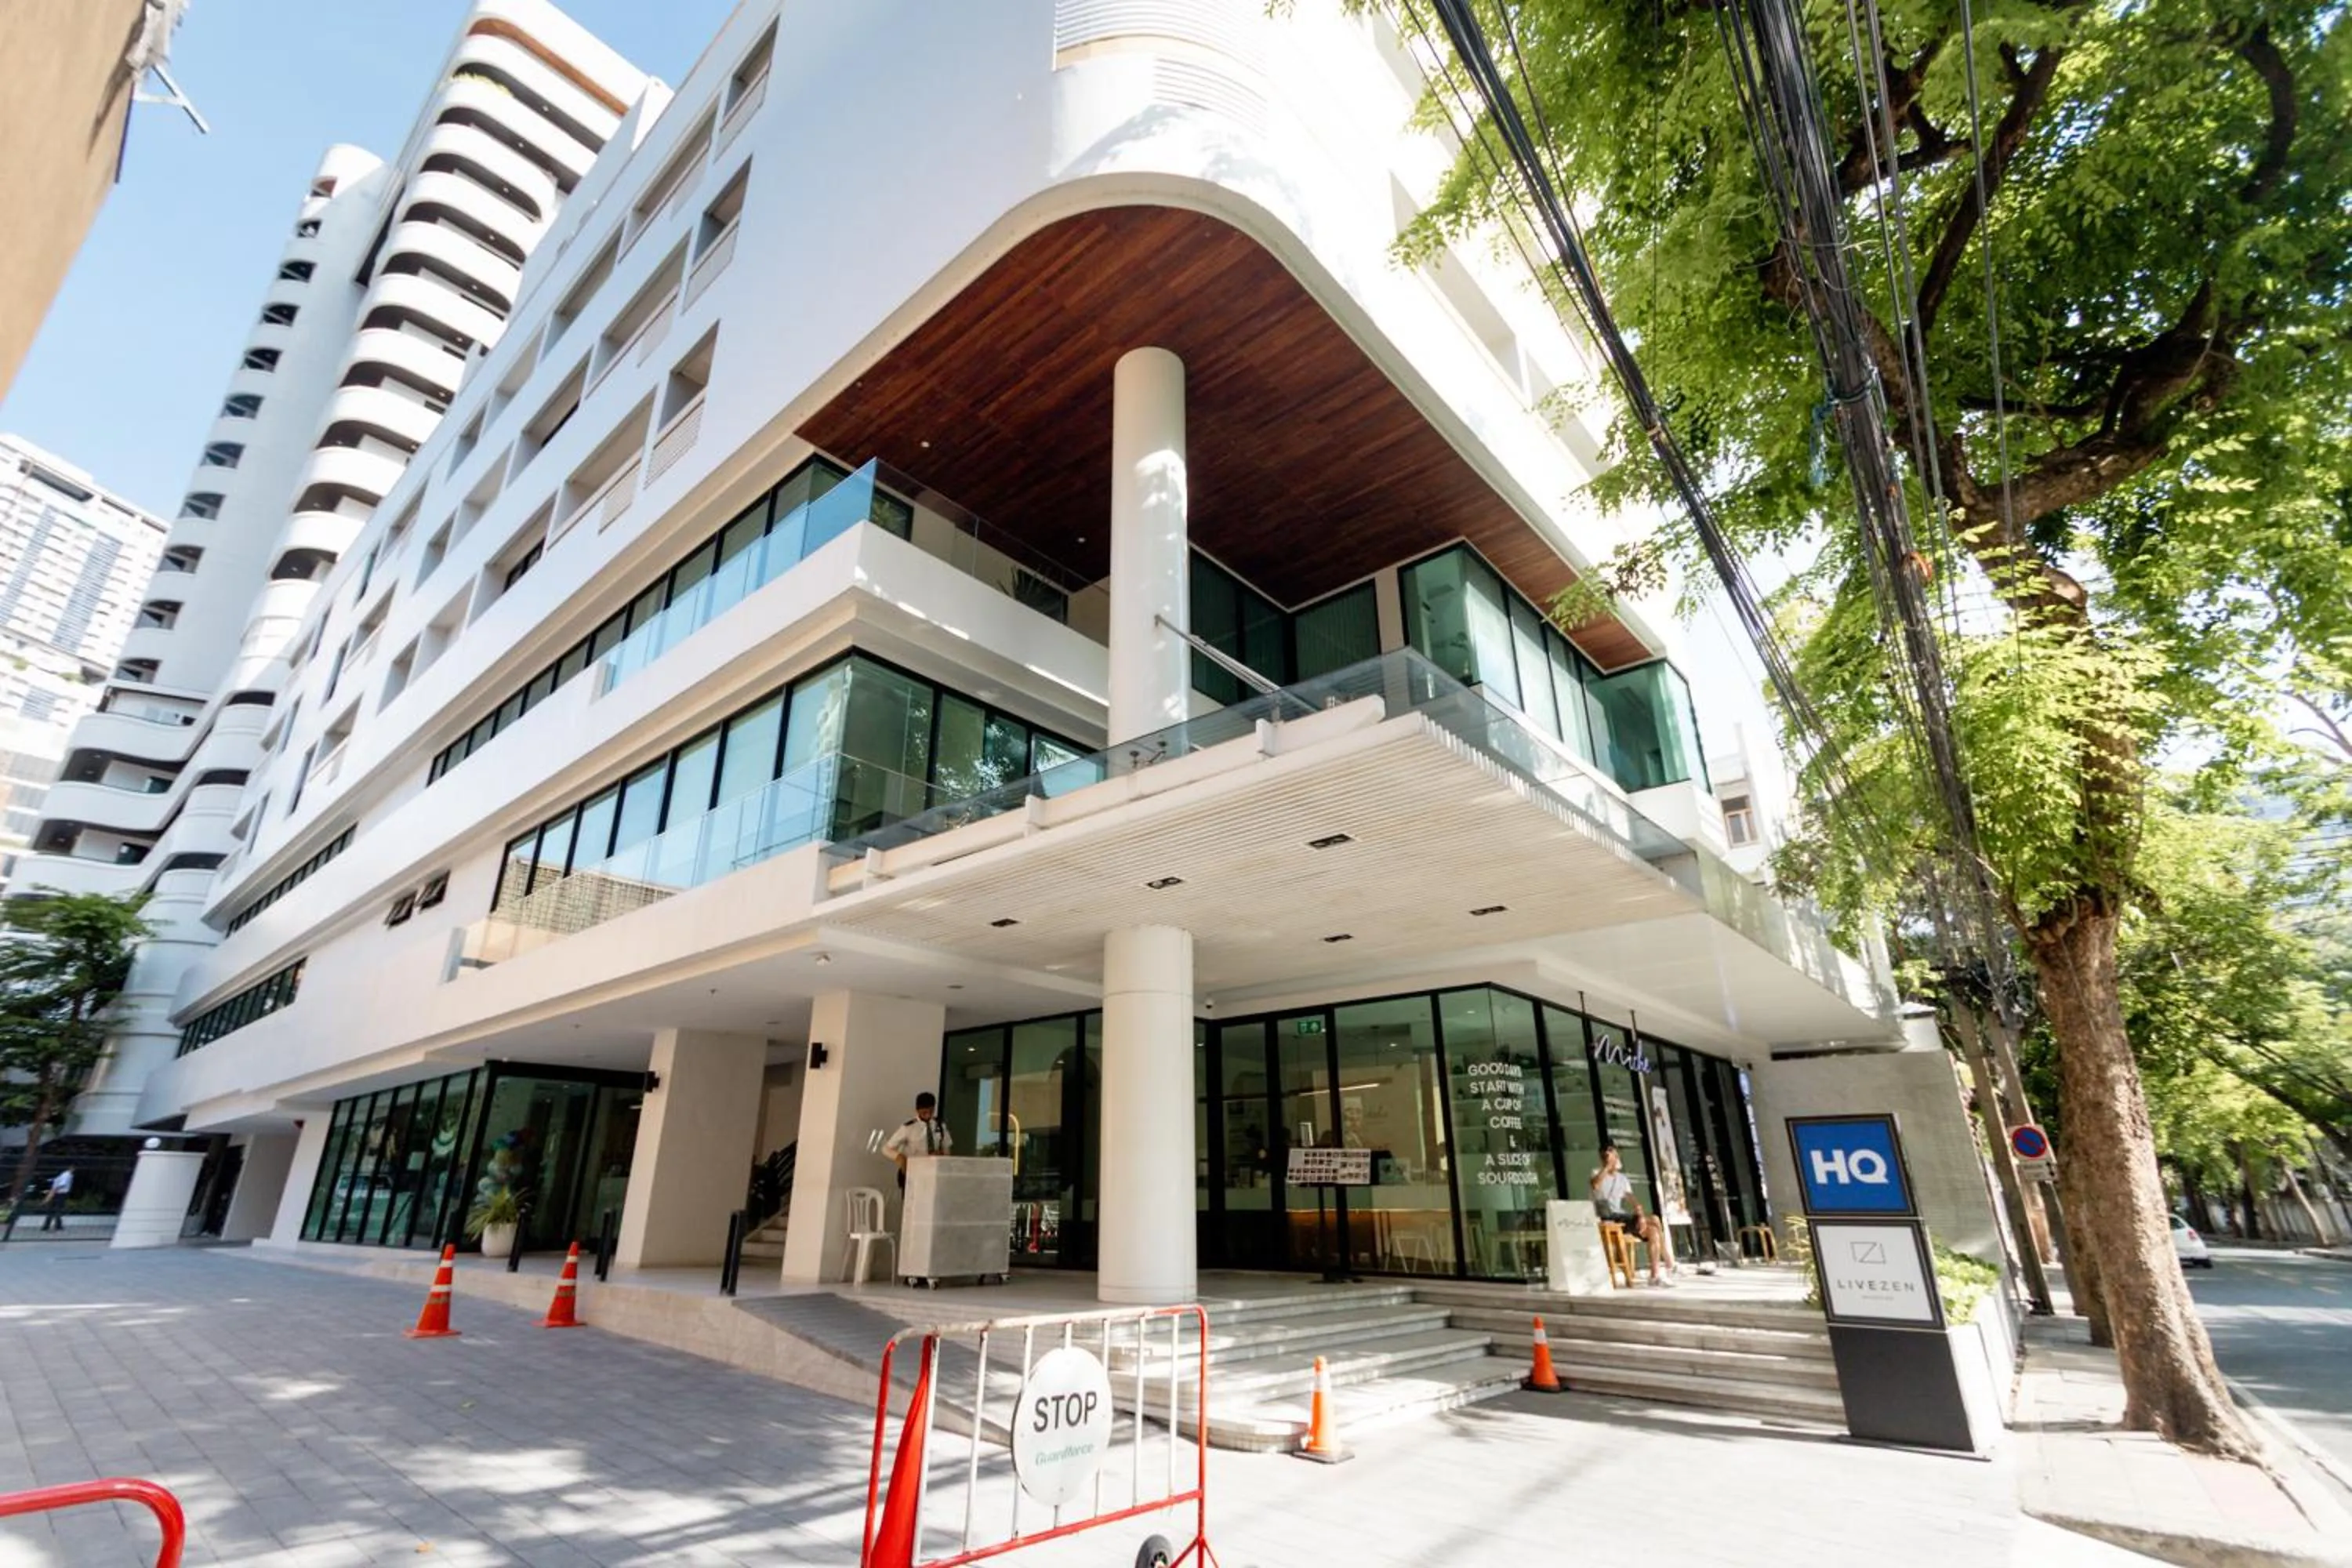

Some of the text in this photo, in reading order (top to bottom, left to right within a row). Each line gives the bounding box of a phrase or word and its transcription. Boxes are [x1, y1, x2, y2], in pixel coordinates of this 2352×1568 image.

[1481, 1098, 1492, 1111] A
[1485, 1153, 1495, 1166] A
[1809, 1149, 1889, 1185] HQ
[1836, 1278, 1916, 1293] LIVEZEN
[1033, 1391, 1098, 1433] STOP
